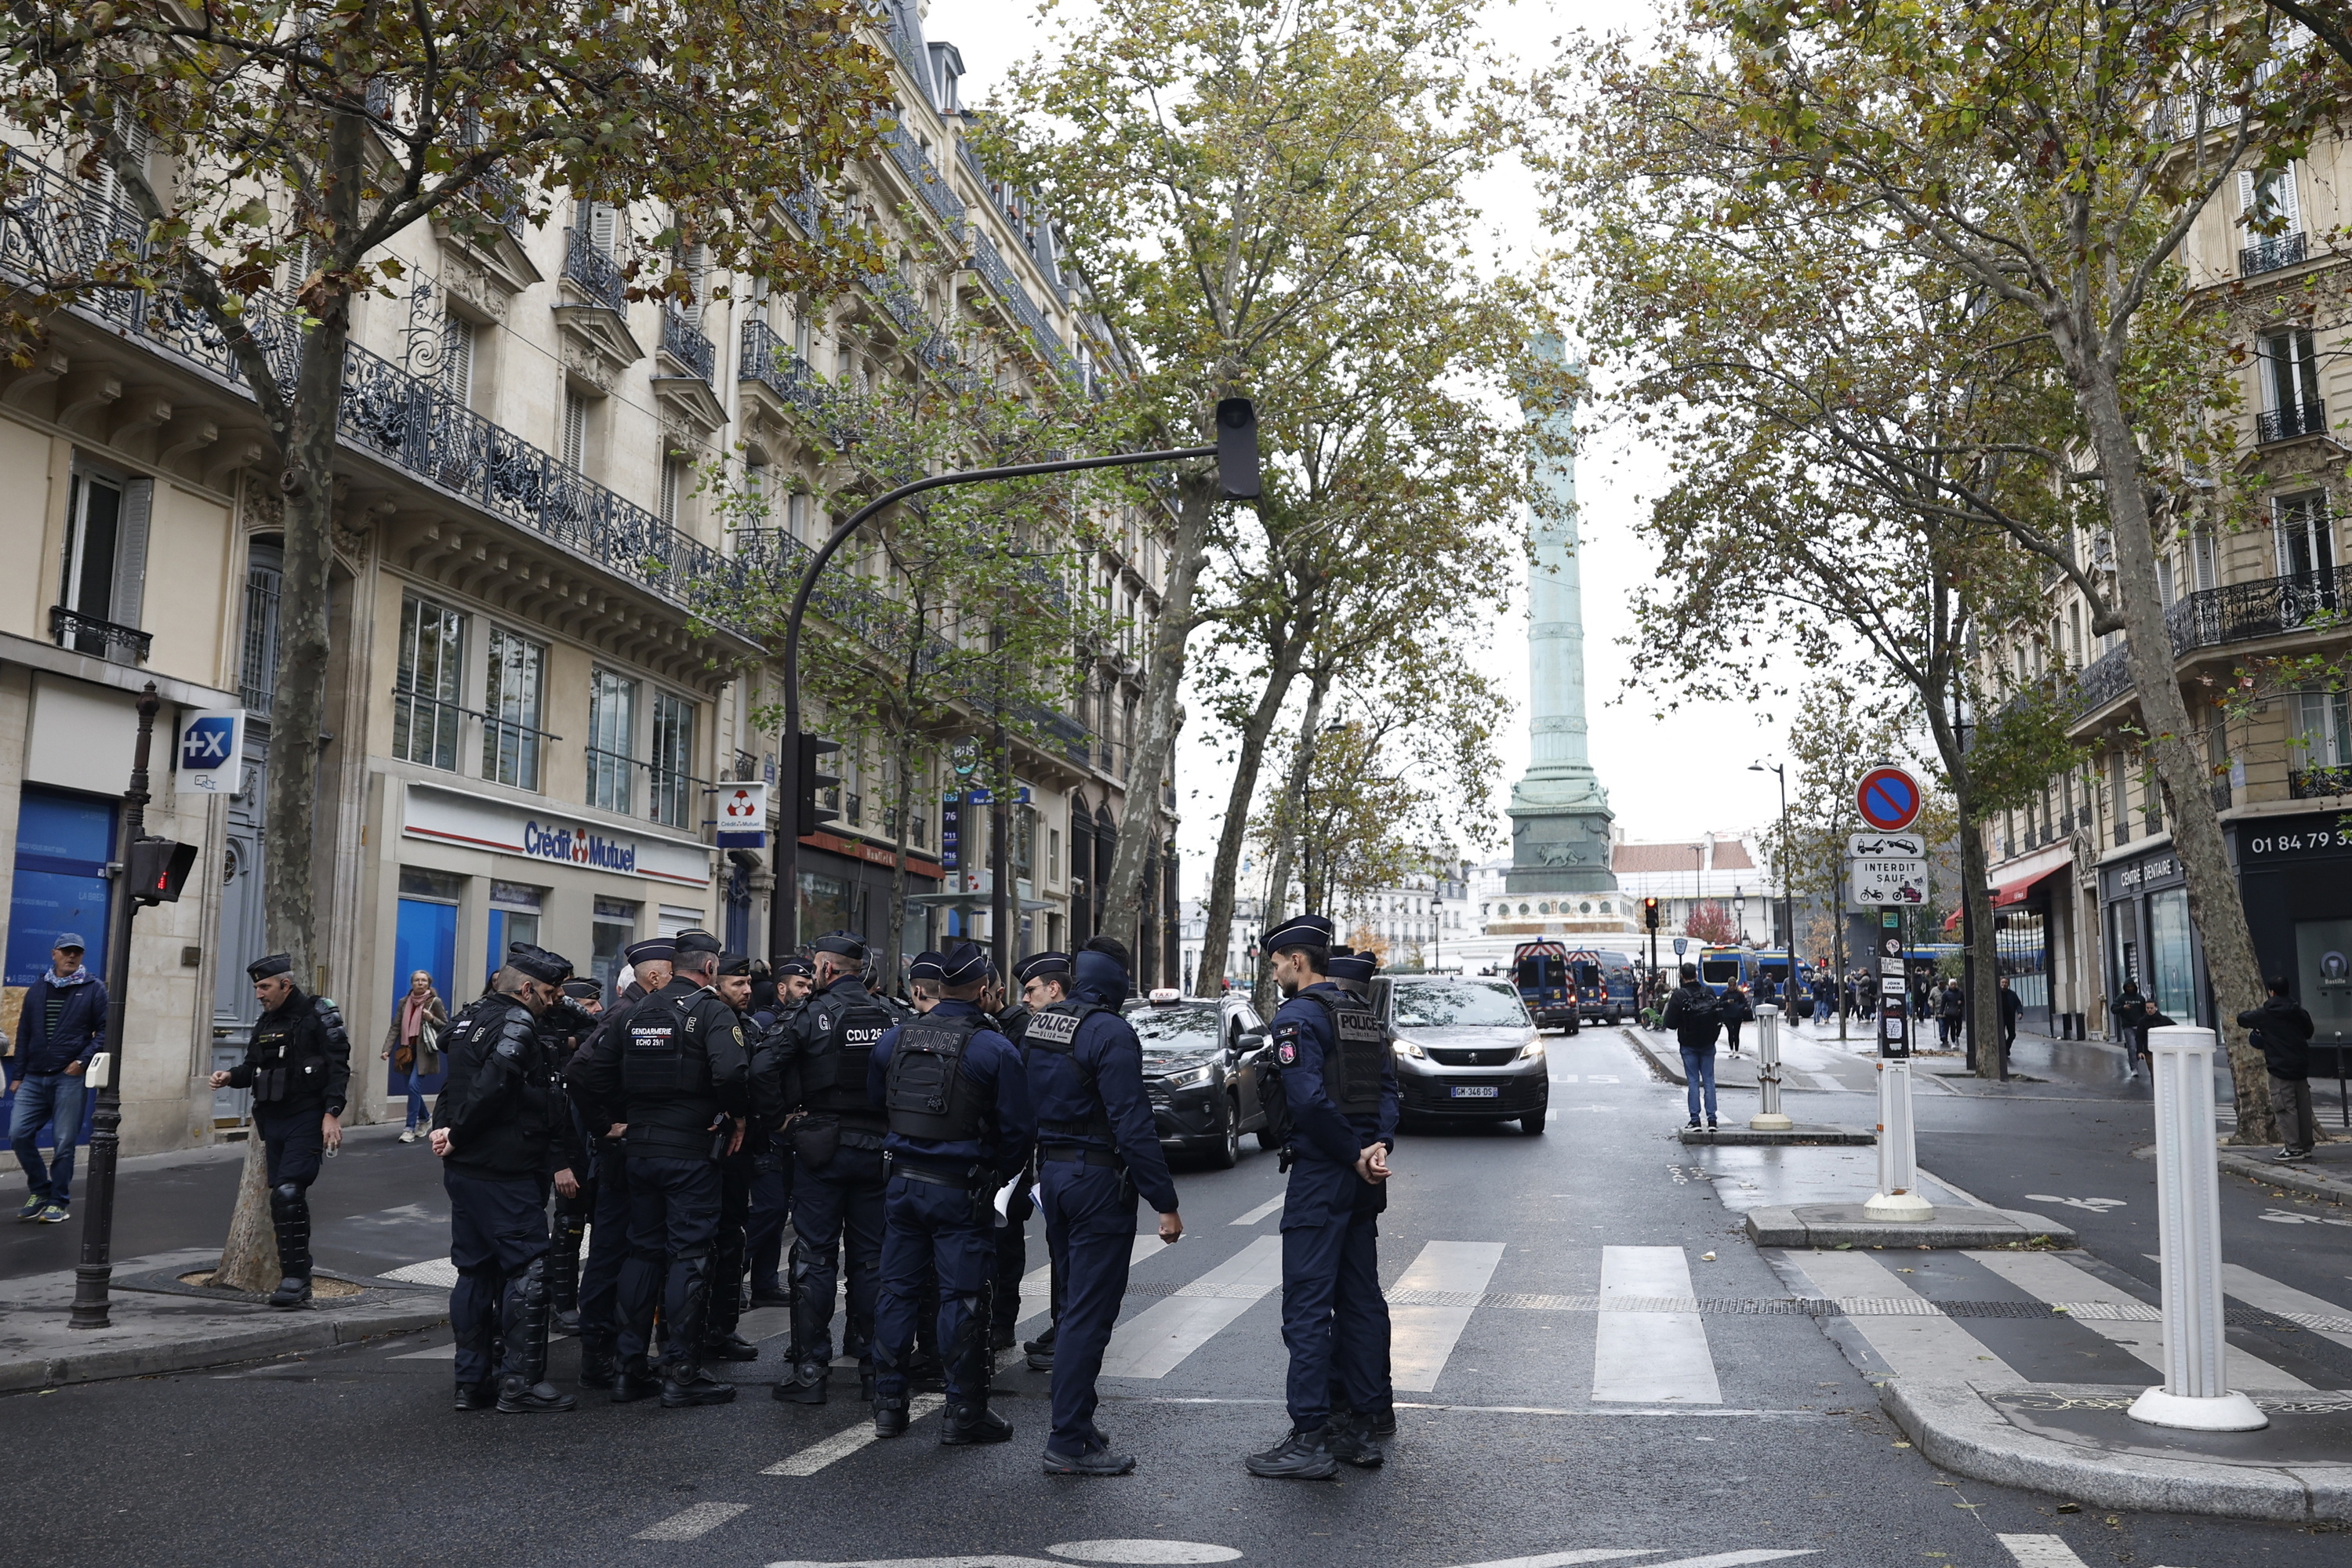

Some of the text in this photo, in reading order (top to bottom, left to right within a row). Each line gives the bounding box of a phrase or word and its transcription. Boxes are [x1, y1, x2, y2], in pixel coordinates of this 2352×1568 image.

[954, 746, 975, 757] BUS
[524, 821, 635, 873] Crédit Mutuel
[2252, 837, 2272, 853] 01
[2278, 834, 2302, 851] 84
[2307, 832, 2329, 848] 79
[1865, 863, 1915, 872] INTERDIT
[2121, 868, 2141, 887] CENTRE
[2143, 858, 2171, 880] DENTAIRE
[1876, 874, 1905, 883] SAUF
[1029, 1014, 1078, 1033] POLICE
[1340, 1014, 1378, 1032] POLICE
[846, 1029, 869, 1041] CDU
[902, 1029, 961, 1051] POLICE
